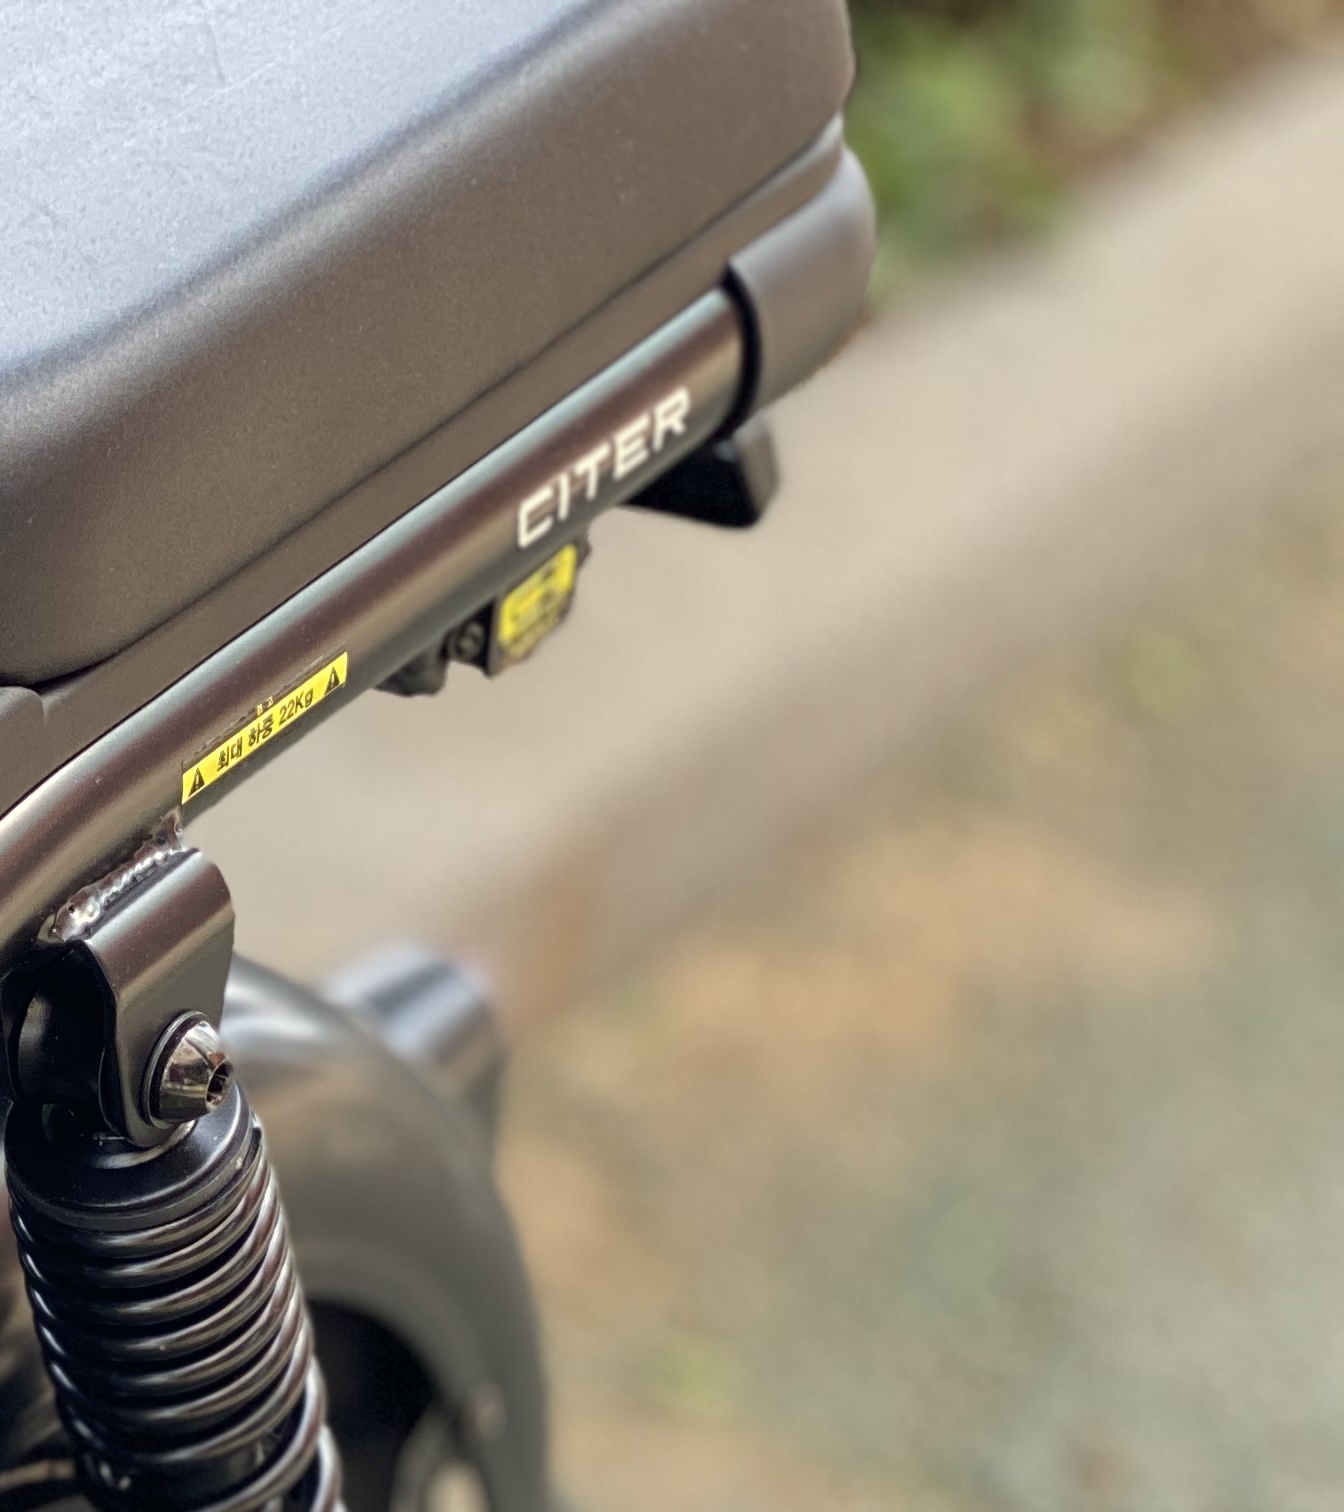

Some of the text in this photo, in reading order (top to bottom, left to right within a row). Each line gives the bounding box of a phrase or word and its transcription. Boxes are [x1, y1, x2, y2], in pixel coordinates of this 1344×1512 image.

[517, 385, 691, 549] CITER
[216, 687, 314, 773] 최대 하중 22Kg
